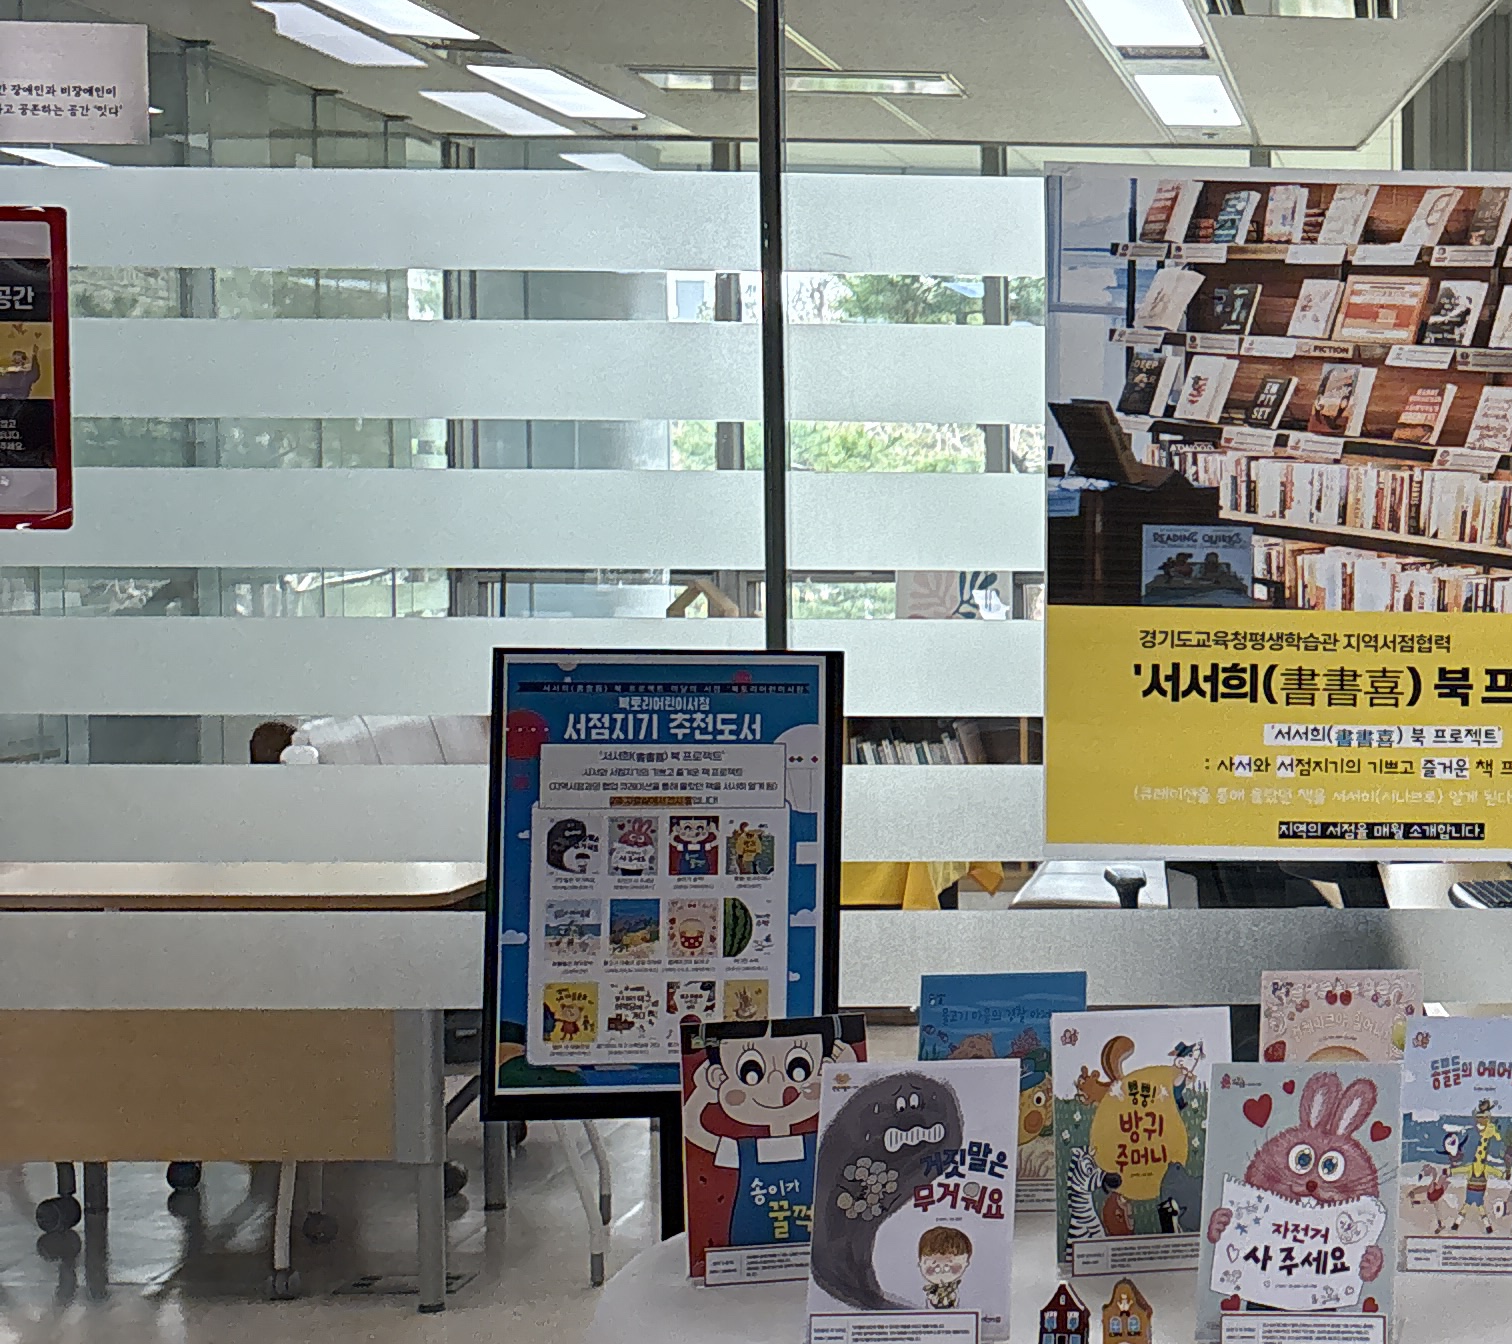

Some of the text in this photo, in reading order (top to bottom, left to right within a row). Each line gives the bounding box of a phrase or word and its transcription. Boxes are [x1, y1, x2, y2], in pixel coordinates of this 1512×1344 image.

[1312, 345, 1350, 355] FICTION
[1251, 407, 1272, 420] SET
[1169, 442, 1215, 454] ATWOOD
[1152, 531, 1198, 544] READING
[1138, 629, 1452, 654] 경기도교육청평생학습관 지역서점협력
[1132, 662, 1423, 708] '서서희(書書喜)
[1433, 666, 1474, 707] 북
[618, 696, 710, 711] 북토리어린이서점
[563, 713, 762, 741] 서점지기 추천도서
[1410, 726, 1426, 746] 북
[1216, 757, 1271, 776] 사서와
[1276, 757, 1361, 777] 서점지기의
[1371, 760, 1416, 775] 기쁘고
[1421, 758, 1470, 778] 즐거운
[1475, 759, 1493, 777] 책
[1278, 822, 1485, 840] 지역의 서점을 매월 소개합니다.
[1029, 1008, 1052, 1019] 아저
[1118, 1112, 1165, 1147] 방귀
[919, 1140, 1010, 1180] 거짓말은
[1115, 1143, 1169, 1171] 주머니
[749, 1176, 800, 1206] 송이가
[912, 1181, 1005, 1221] 무거워요
[1271, 1220, 1331, 1246] 자전거
[1243, 1244, 1352, 1277] 사 주세요
